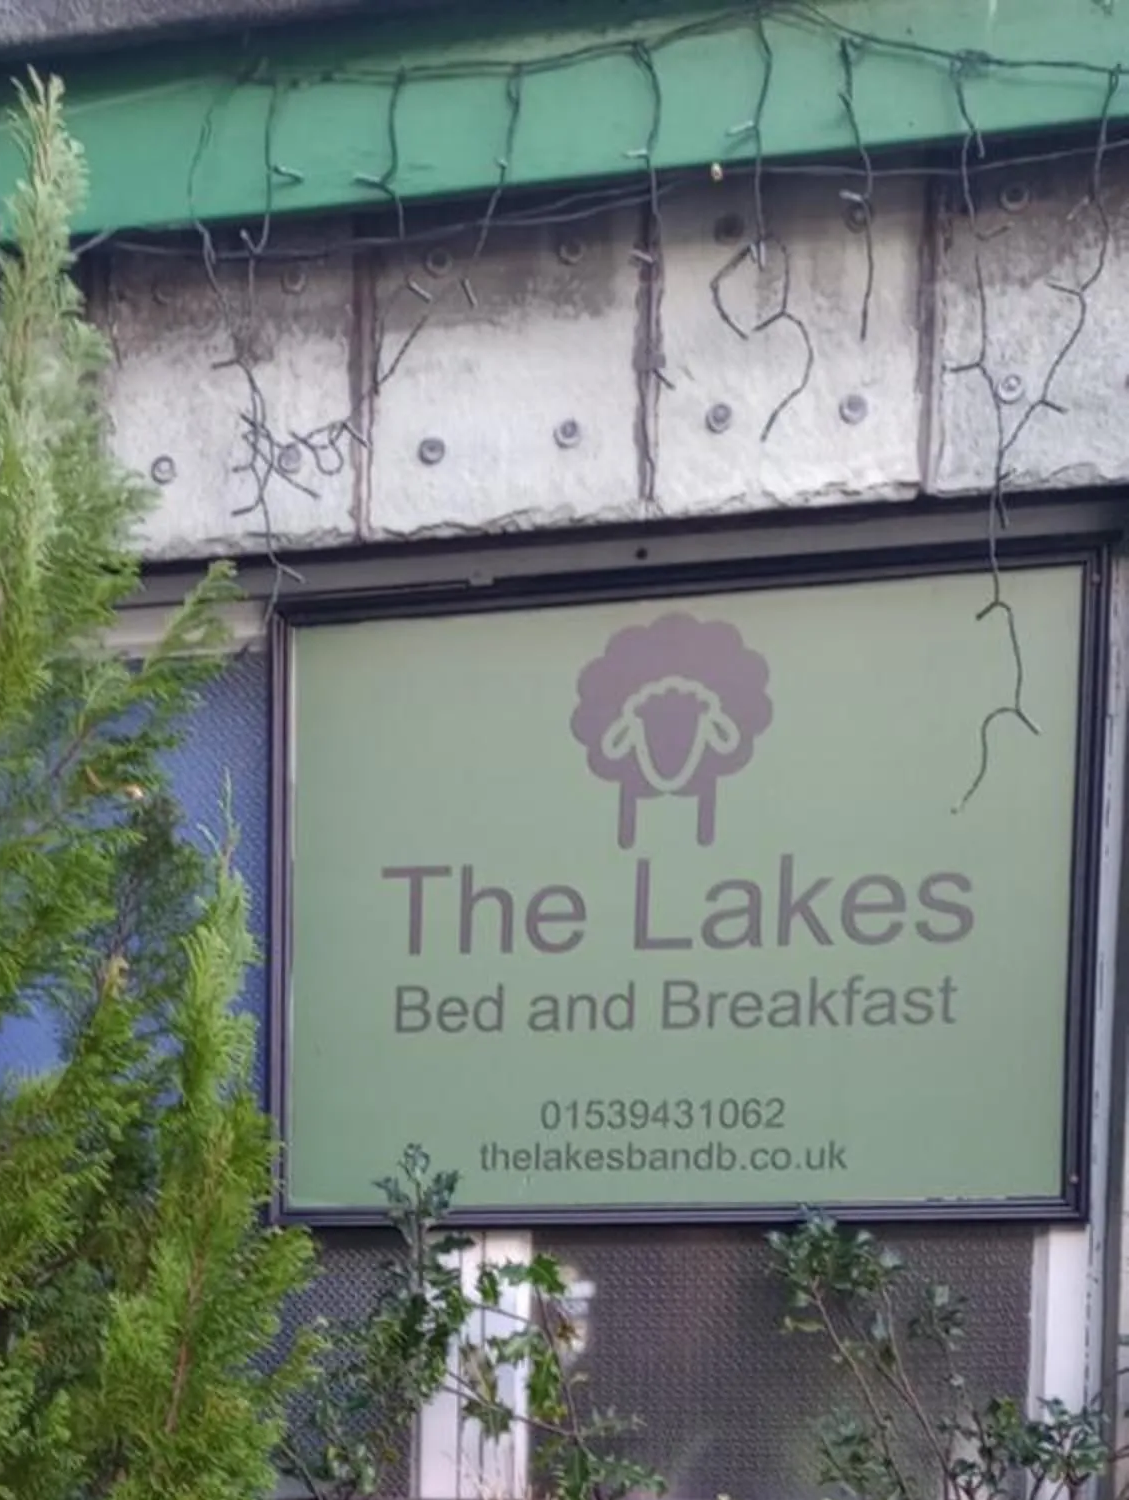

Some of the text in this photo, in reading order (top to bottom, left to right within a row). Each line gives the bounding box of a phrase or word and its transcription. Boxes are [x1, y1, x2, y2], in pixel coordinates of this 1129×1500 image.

[381, 853, 975, 956] The Lakes
[394, 974, 958, 1034] Bed and Breakfast
[540, 1097, 785, 1131] 01539431062
[480, 1140, 847, 1172] thelakesbandb.co.uk
